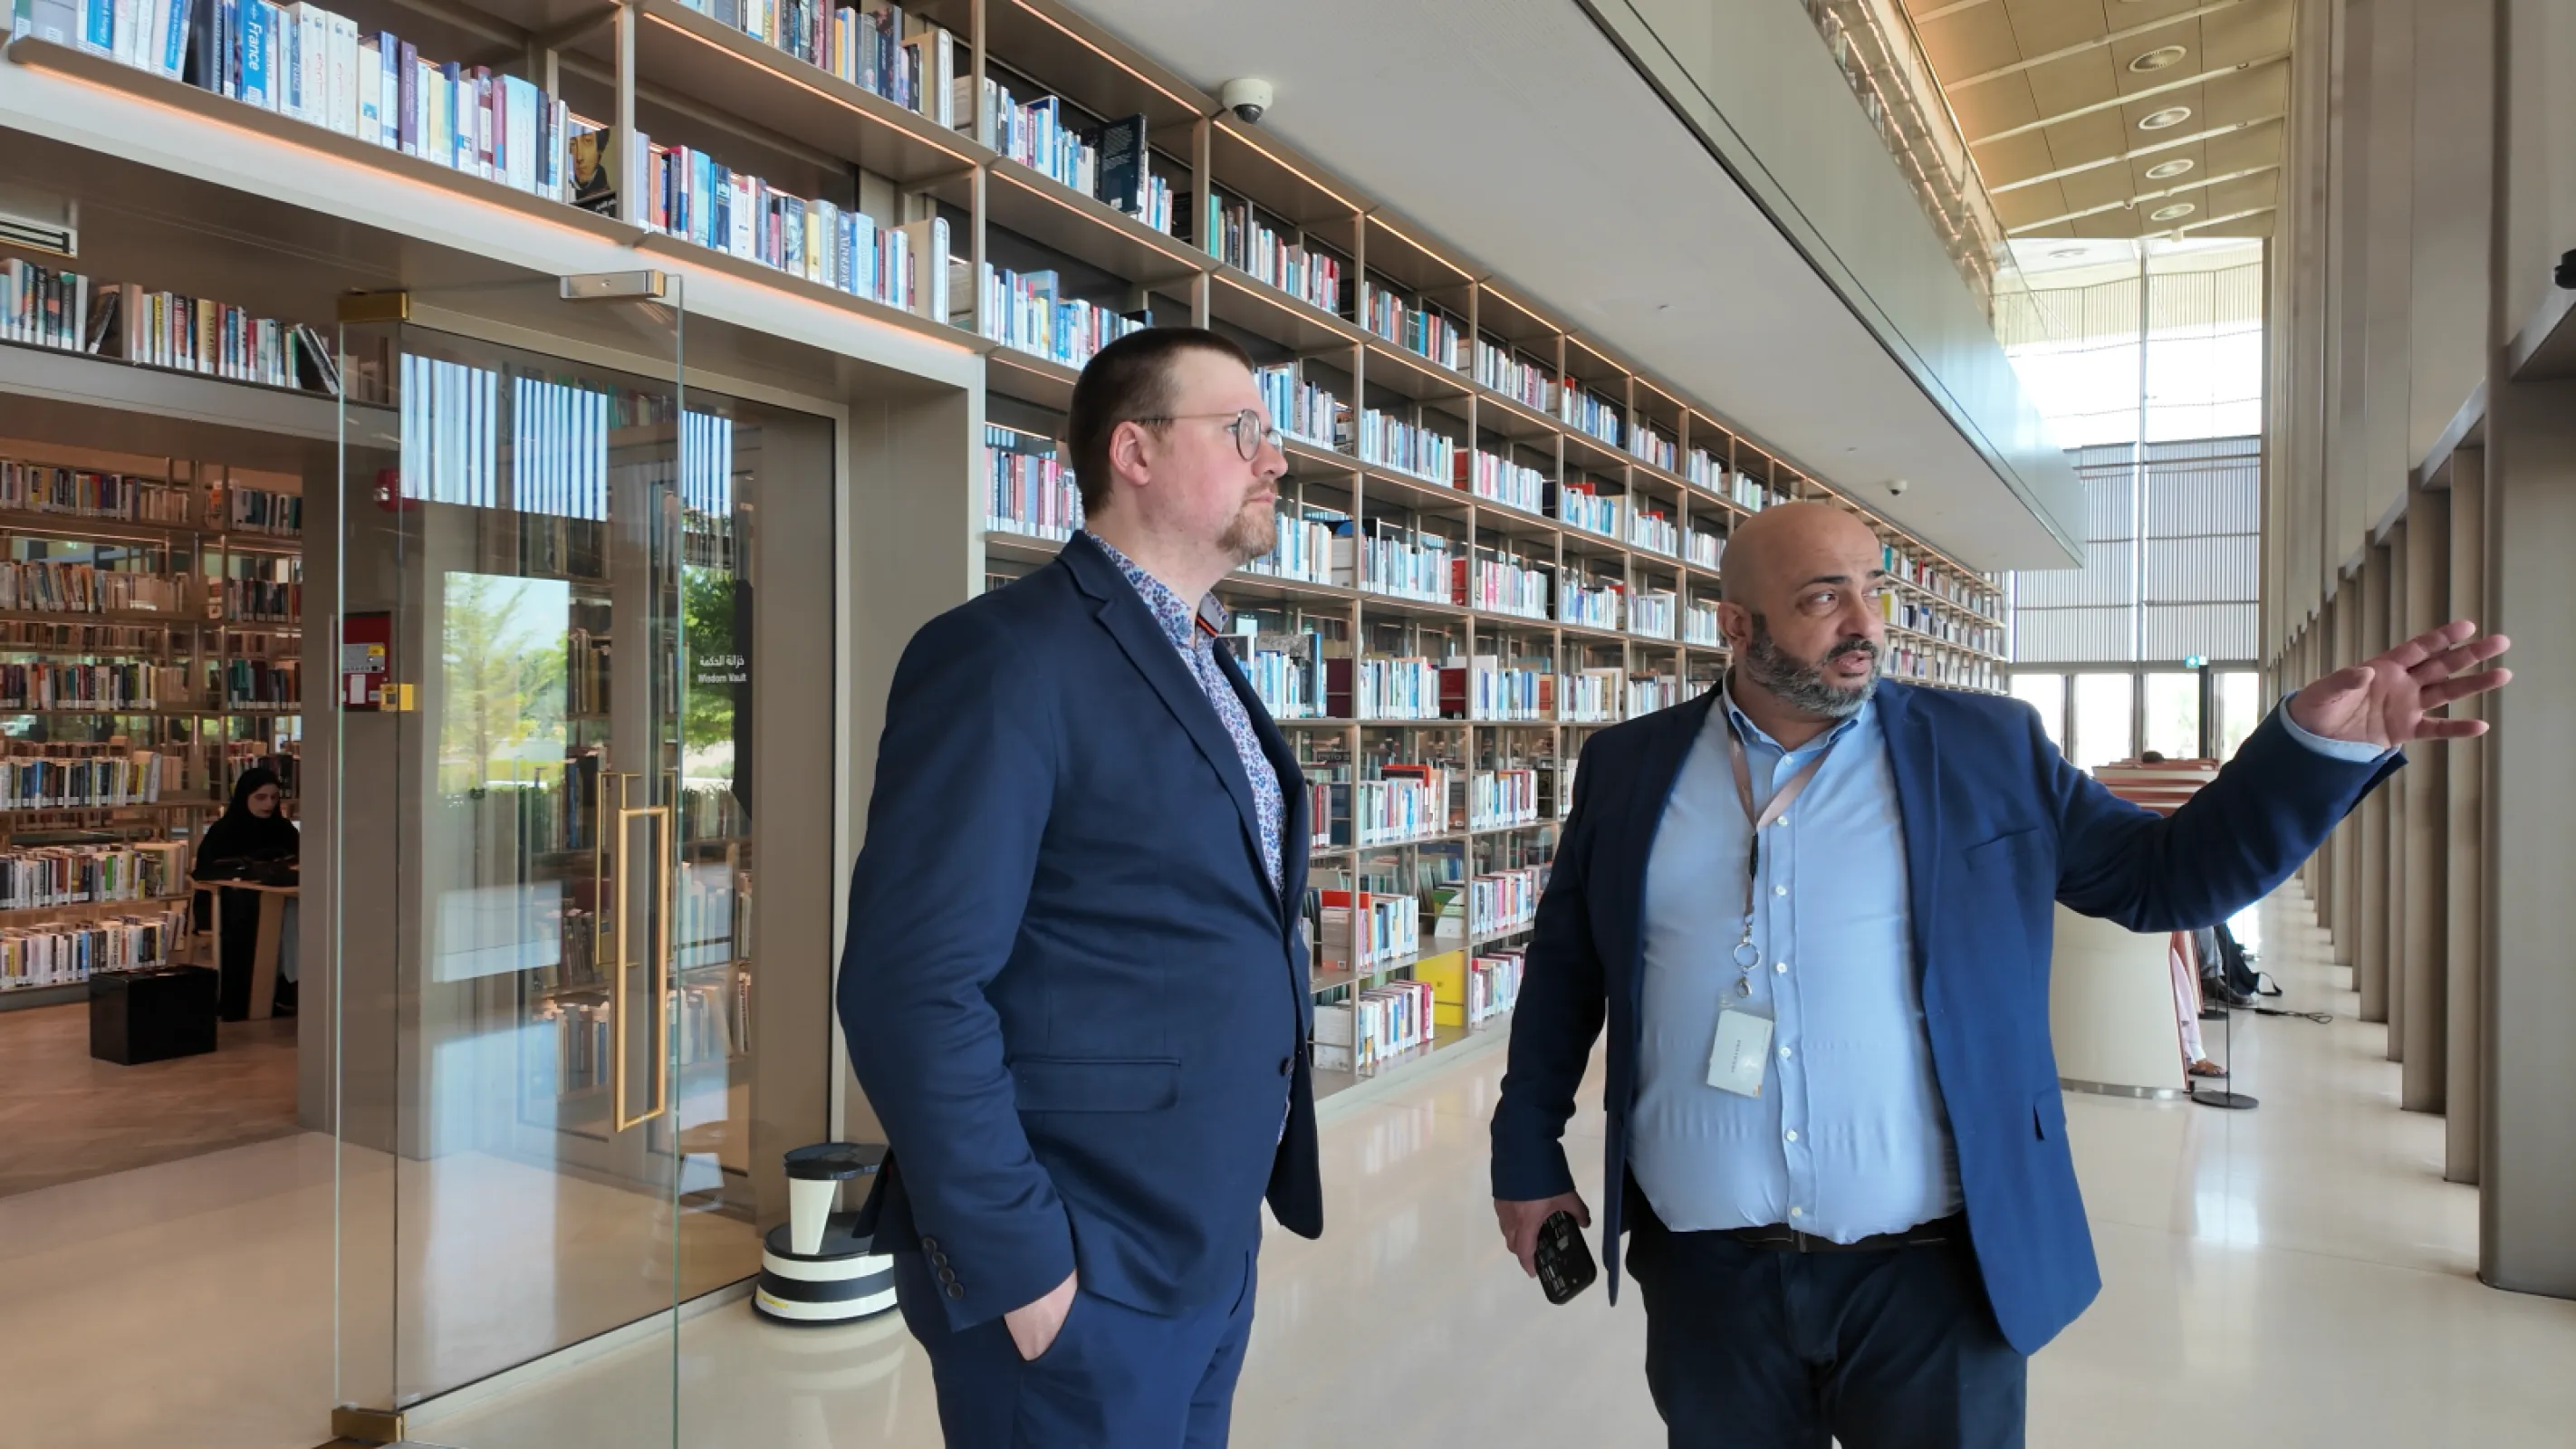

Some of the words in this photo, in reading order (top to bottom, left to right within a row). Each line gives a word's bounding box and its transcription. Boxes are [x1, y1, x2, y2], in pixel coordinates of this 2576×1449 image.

[247, 21, 264, 72] France
[698, 673, 726, 683] Wisdom
[728, 673, 746, 683] Vault
